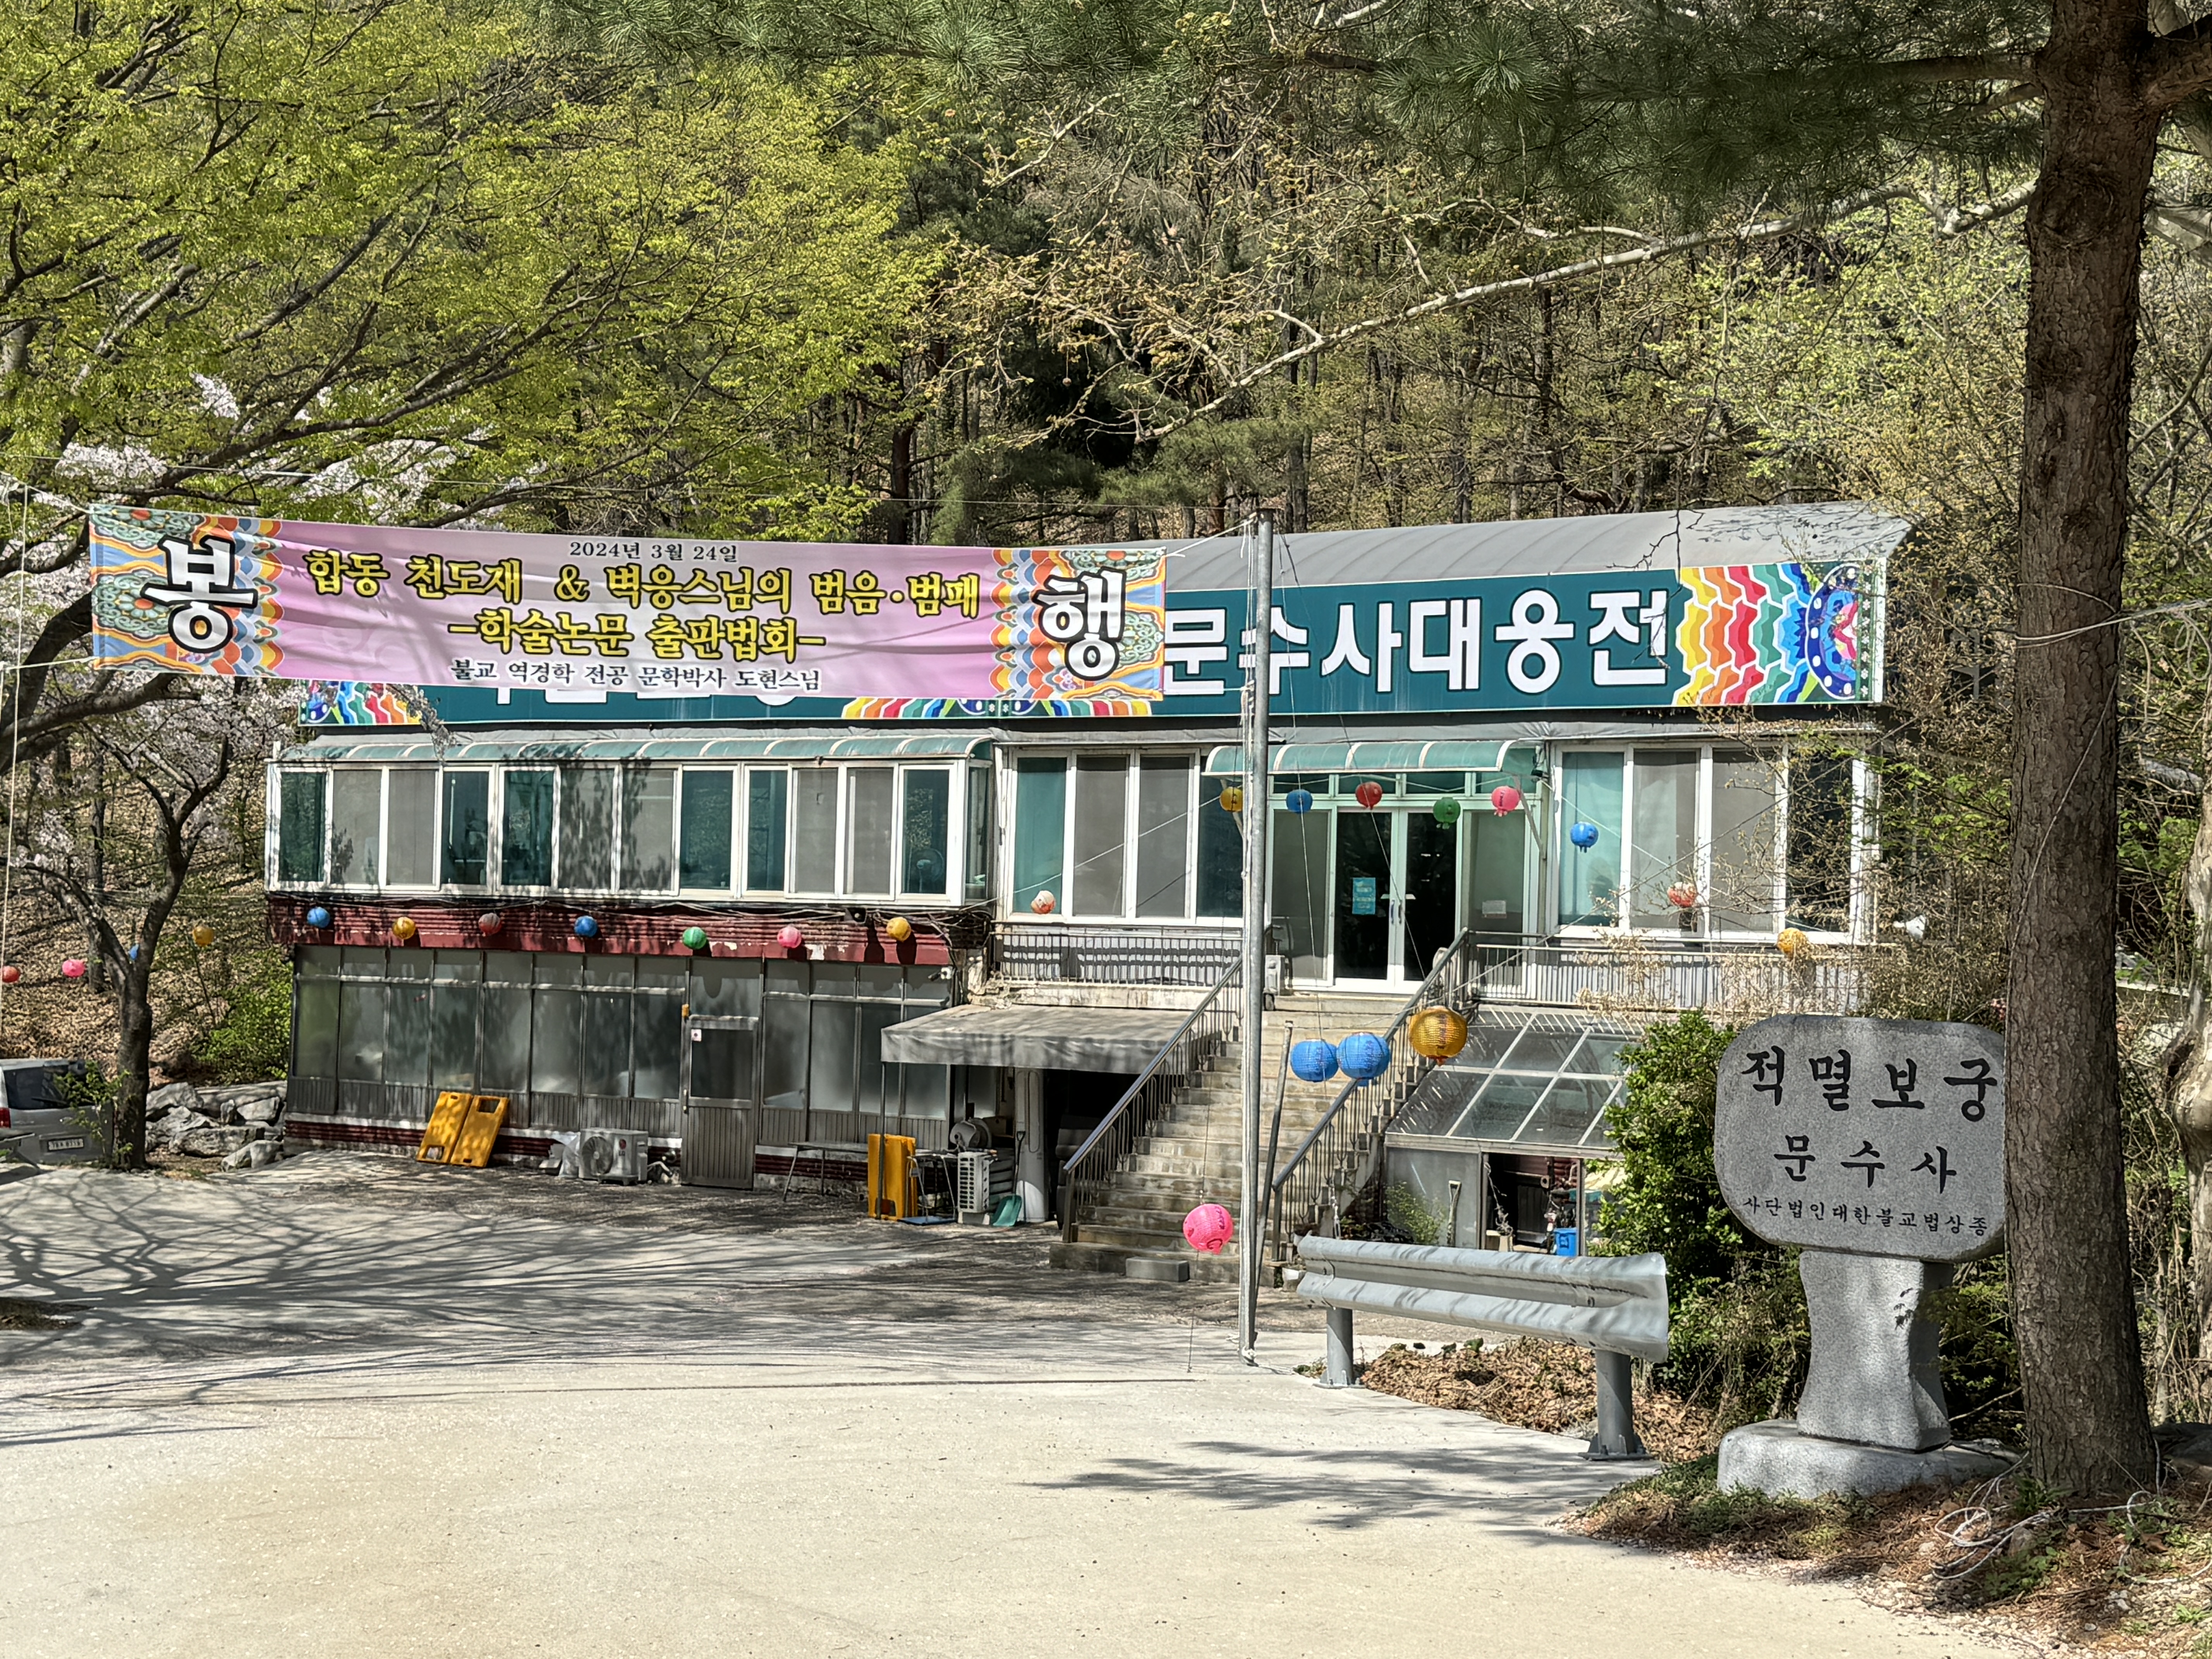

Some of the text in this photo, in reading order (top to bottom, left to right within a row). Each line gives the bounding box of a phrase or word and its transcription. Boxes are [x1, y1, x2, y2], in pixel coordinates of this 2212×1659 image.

[303, 549, 390, 597] 합동
[404, 554, 523, 604] 천도재
[554, 564, 590, 602] &
[604, 563, 792, 614] 벽응스님의
[570, 541, 738, 562] 2024년 3월 24일
[140, 534, 258, 654] 봉
[1036, 568, 1126, 680] 행
[451, 659, 820, 691] 불교 역경학 전공 문학박사 도현스님
[1741, 1045, 1998, 1122] 적멸보궁
[1774, 1135, 1957, 1194] 문수사
